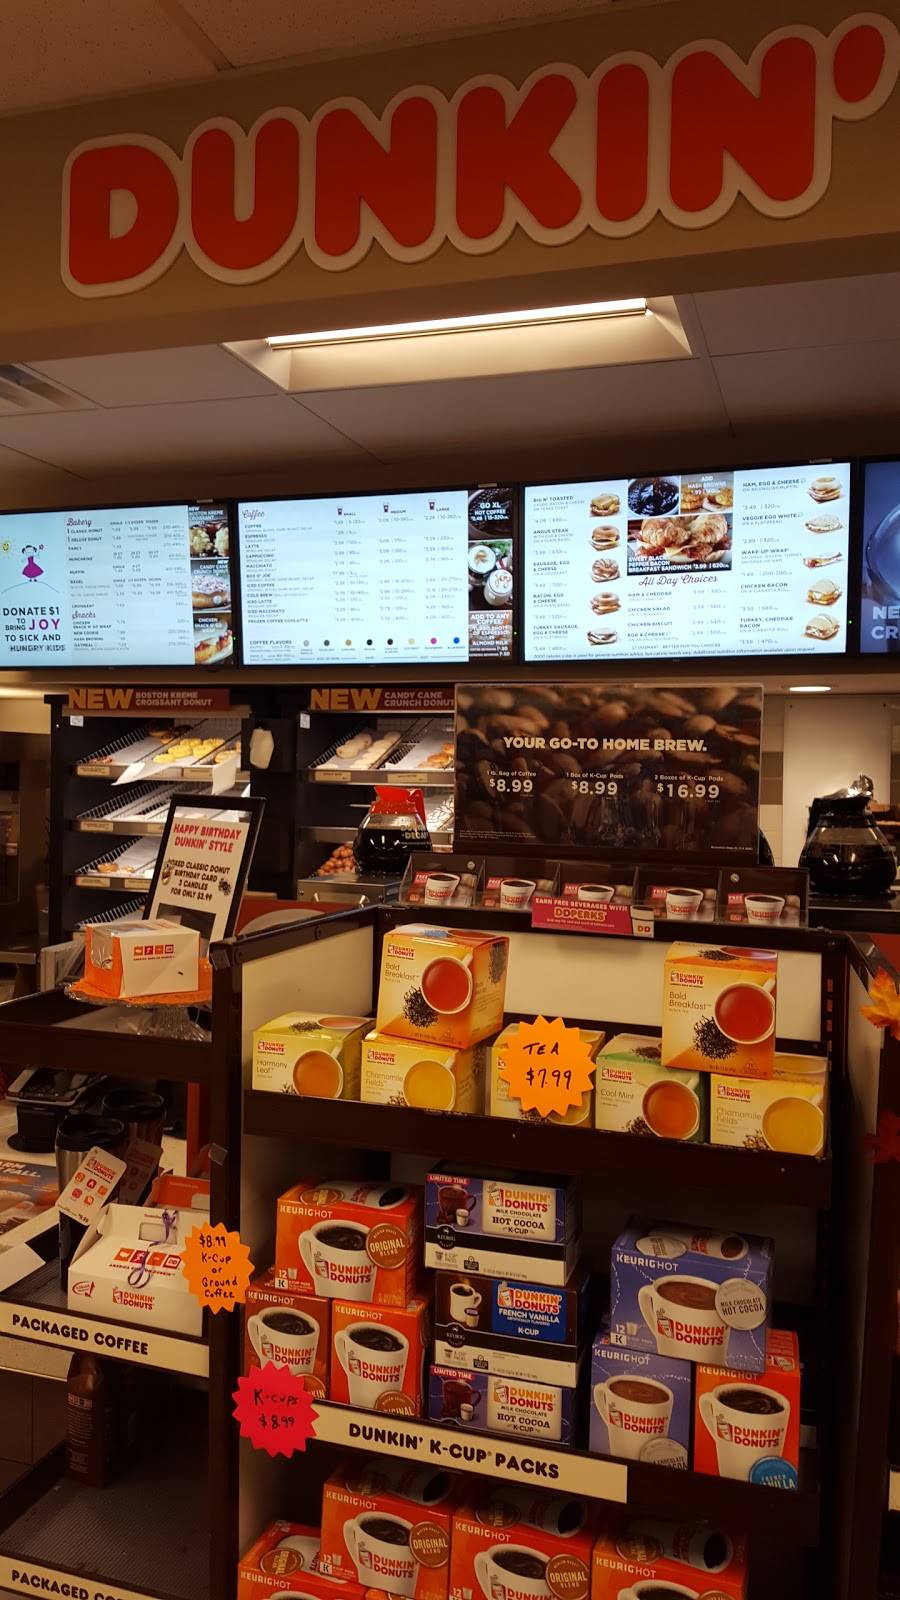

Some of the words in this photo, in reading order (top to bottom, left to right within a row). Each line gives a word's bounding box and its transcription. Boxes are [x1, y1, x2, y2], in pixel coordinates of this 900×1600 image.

[66, 22, 888, 288] DUNKIN'
[242, 509, 264, 520] Coffee
[638, 576, 655, 587] All
[656, 575, 679, 588] Day
[681, 574, 719, 584] Choices
[3, 607, 46, 616] DONATE
[49, 606, 60, 616] $1
[29, 618, 60, 630] JOY
[5, 634, 16, 642] TO
[42, 633, 61, 641] AND
[10, 644, 43, 652] HUNGRY
[47, 644, 66, 652] KIDS
[68, 688, 134, 709] NEW
[136, 691, 168, 699] BOSTON
[311, 688, 383, 710] NEW
[384, 691, 415, 699] CANDY
[417, 691, 442, 699] CANE
[183, 698, 212, 706] DONUT
[384, 699, 421, 707] CRUNCH
[423, 699, 455, 707] DONUT
[503, 736, 545, 749] YOUR
[550, 737, 599, 750] GO-TO
[603, 738, 650, 751] HOME
[653, 739, 707, 752] BREW.
[489, 778, 534, 794] $8.99
[571, 780, 618, 796] $8.99
[657, 783, 720, 799] $16.99
[173, 823, 199, 836] HAPPY
[200, 826, 242, 841] BIRTHDAY
[174, 837, 207, 850] DUNKIN'
[208, 841, 234, 853] STYLE
[185, 861, 209, 872] CLASSIC
[209, 865, 230, 875] DONUT
[174, 869, 201, 880] BIRTHDAY
[202, 873, 218, 882] CARD
[183, 880, 208, 891] CANDLES
[170, 887, 181, 896] FOR
[182, 889, 197, 899] ONLY
[197, 892, 212, 902] $2.99
[570, 901, 606, 909] BEVERAGES
[637, 925, 651, 933] DD
[386, 963, 400, 971] Bold
[679, 972, 704, 981] DUNKIN'
[669, 992, 686, 1001] Bold
[523, 1042, 559, 1056] TEA
[256, 1059, 288, 1070] Harmony
[256, 1066, 270, 1074] Leaf
[366, 1071, 404, 1082] Chamomile
[525, 1069, 572, 1090] $7.99
[601, 1089, 618, 1099] Cool
[620, 1089, 634, 1099] Mint
[430, 1175, 452, 1183] LIMITED
[453, 1177, 468, 1185] TIME
[504, 1190, 550, 1203] DUNKIN'
[504, 1200, 548, 1212] DONUTS
[510, 1210, 542, 1218] CHOCOLATE
[492, 1216, 512, 1226] HOT
[514, 1218, 545, 1230] COCOA
[508, 1227, 528, 1235] K-CUP
[200, 1234, 226, 1248] $8.99
[370, 1238, 405, 1252] ORIGINAL
[330, 1262, 375, 1274] DUNKIN'
[202, 1278, 238, 1288] Ground
[330, 1272, 371, 1284] DONUTS
[123, 1292, 155, 1302] DUNKIN'
[514, 1291, 562, 1306] DUNKIN'
[123, 1299, 153, 1310] DONUTS
[514, 1301, 561, 1315] DONUTS
[722, 1306, 737, 1315] HOT
[738, 1304, 764, 1314] COCOA
[499, 1308, 528, 1319] FRENCH
[528, 1312, 560, 1324] VANILLA
[12, 1313, 89, 1342] PACKAGED
[93, 1333, 149, 1356] COFFEE
[518, 1327, 540, 1336] K-CUP
[675, 1321, 728, 1336] DUNKIN'
[675, 1332, 724, 1346] DONUTS
[274, 1345, 314, 1357] DUNKIN'
[274, 1355, 311, 1365] DONUTS
[362, 1361, 403, 1374] DUNKIN'
[362, 1370, 400, 1382] DONUTS
[510, 1388, 556, 1401] DUNKIN'
[510, 1398, 554, 1412] DONUTS
[259, 1414, 295, 1429] $8.99
[734, 1428, 784, 1440] DUNKIN'
[734, 1436, 779, 1448] DONUTS
[349, 1423, 423, 1450] DUNKIN'
[430, 1439, 488, 1463] K-CUP
[495, 1452, 559, 1480] PACKS
[412, 1538, 448, 1550] ORIGINAL
[374, 1556, 418, 1570] DUNKIN'
[374, 1566, 414, 1578] DONUTS
